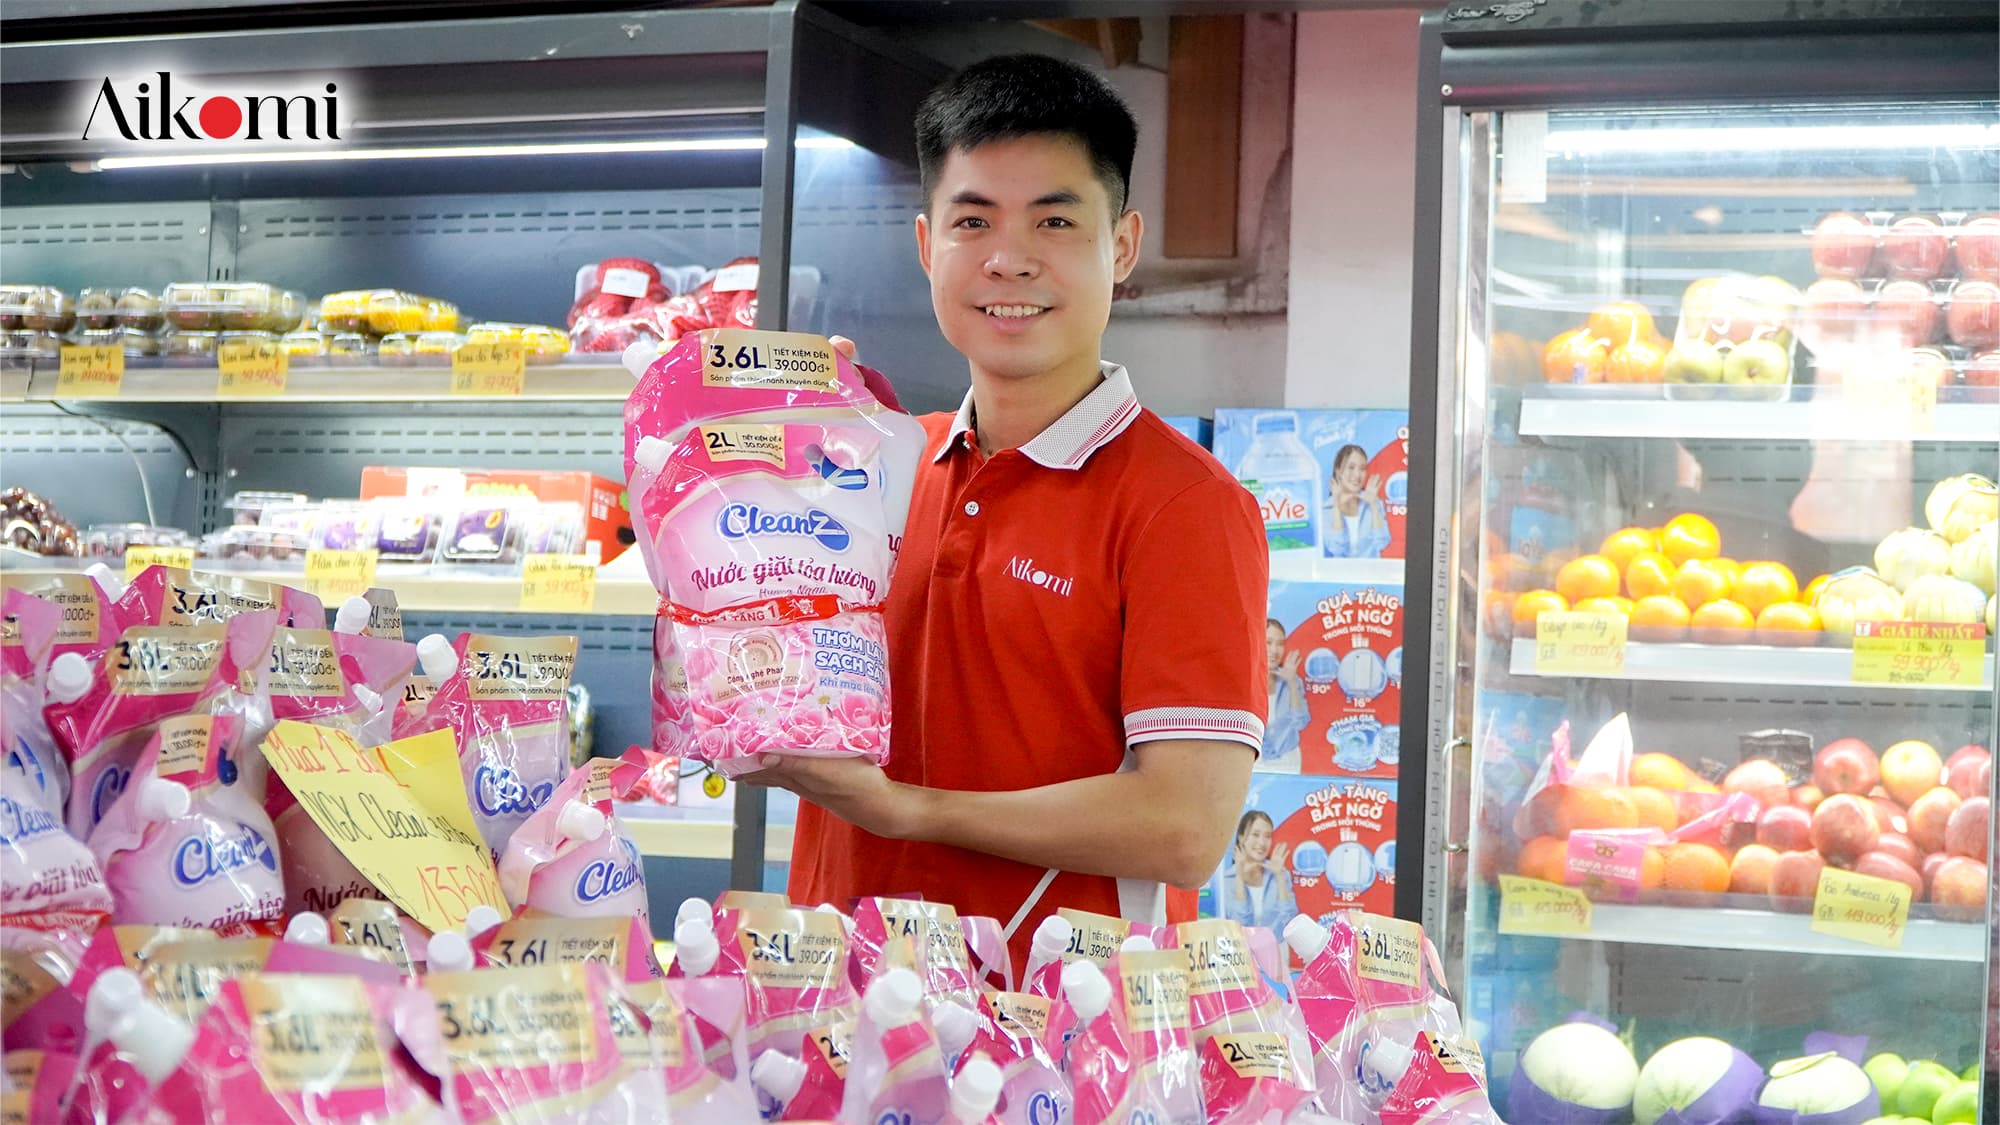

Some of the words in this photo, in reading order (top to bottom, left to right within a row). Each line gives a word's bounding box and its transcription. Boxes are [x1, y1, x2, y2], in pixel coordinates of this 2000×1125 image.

[710, 344, 767, 369] 3.6L
[773, 348, 790, 356] TIẾT
[791, 349, 811, 358] KIỆM
[813, 350, 829, 359] ĐẾN
[775, 359, 831, 373] 39.000đ+
[706, 431, 736, 449] 2L
[1260, 498, 1306, 520] aVie
[719, 502, 850, 551] CleanZ
[691, 561, 747, 592] Nước
[798, 557, 825, 582] tỏa
[828, 563, 877, 600] hương
[1003, 555, 1073, 597] Aikomi
[1317, 590, 1352, 614] QUÀ
[1355, 586, 1399, 610] TẶNG
[1322, 608, 1354, 630] BẤT
[1358, 607, 1394, 626] NGỜ
[813, 628, 866, 655] THƠM
[1932, 623, 1975, 640] NHẤT
[476, 652, 528, 679] 3.6L
[815, 651, 866, 676] SẠCH
[265, 727, 326, 773] Mua
[1305, 784, 1341, 807] QUÀ
[1344, 782, 1389, 804] TẶNG
[1310, 800, 1343, 823] BẤT
[1346, 802, 1384, 820] NGỜ
[1362, 929, 1391, 961] 3.6L
[1223, 1042, 1255, 1063] 2L
